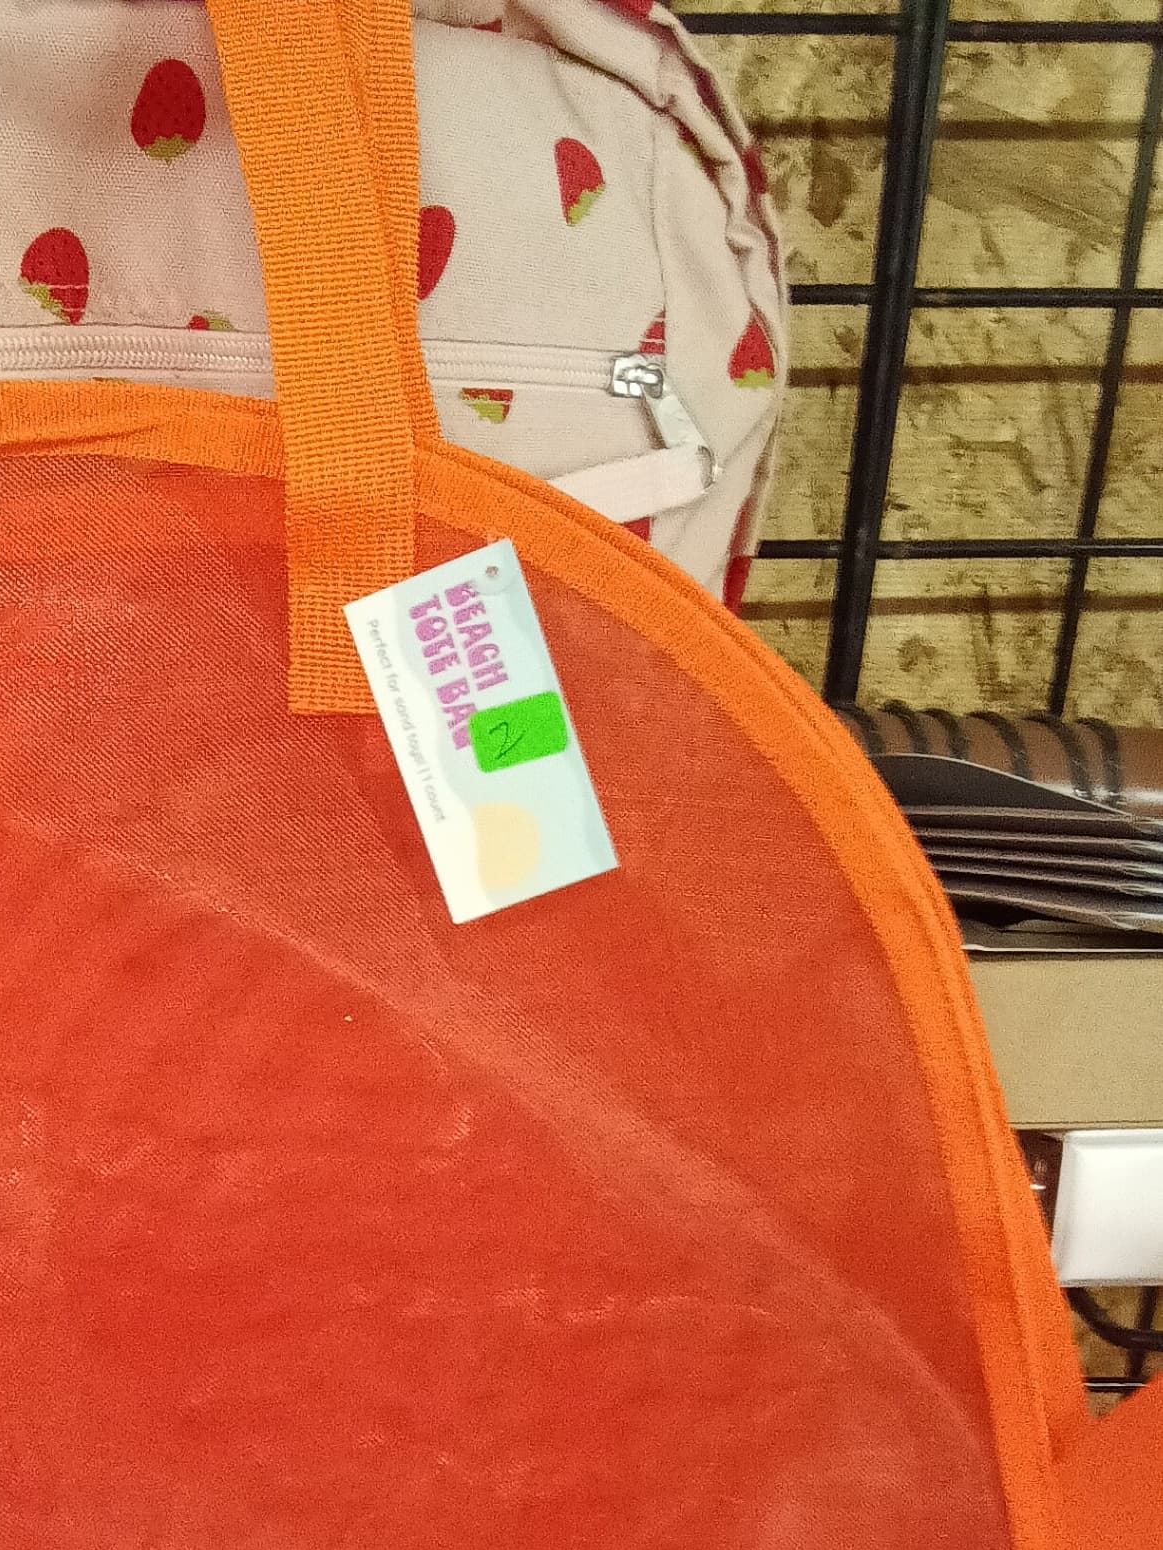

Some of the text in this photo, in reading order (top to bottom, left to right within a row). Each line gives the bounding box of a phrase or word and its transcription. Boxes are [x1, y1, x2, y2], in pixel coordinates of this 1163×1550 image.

[367, 619, 393, 670] Perfect
[408, 595, 461, 676] TOTE
[444, 580, 509, 692] BEACH
[386, 673, 401, 694] for
[392, 695, 416, 732] sand
[424, 784, 446, 822] count
